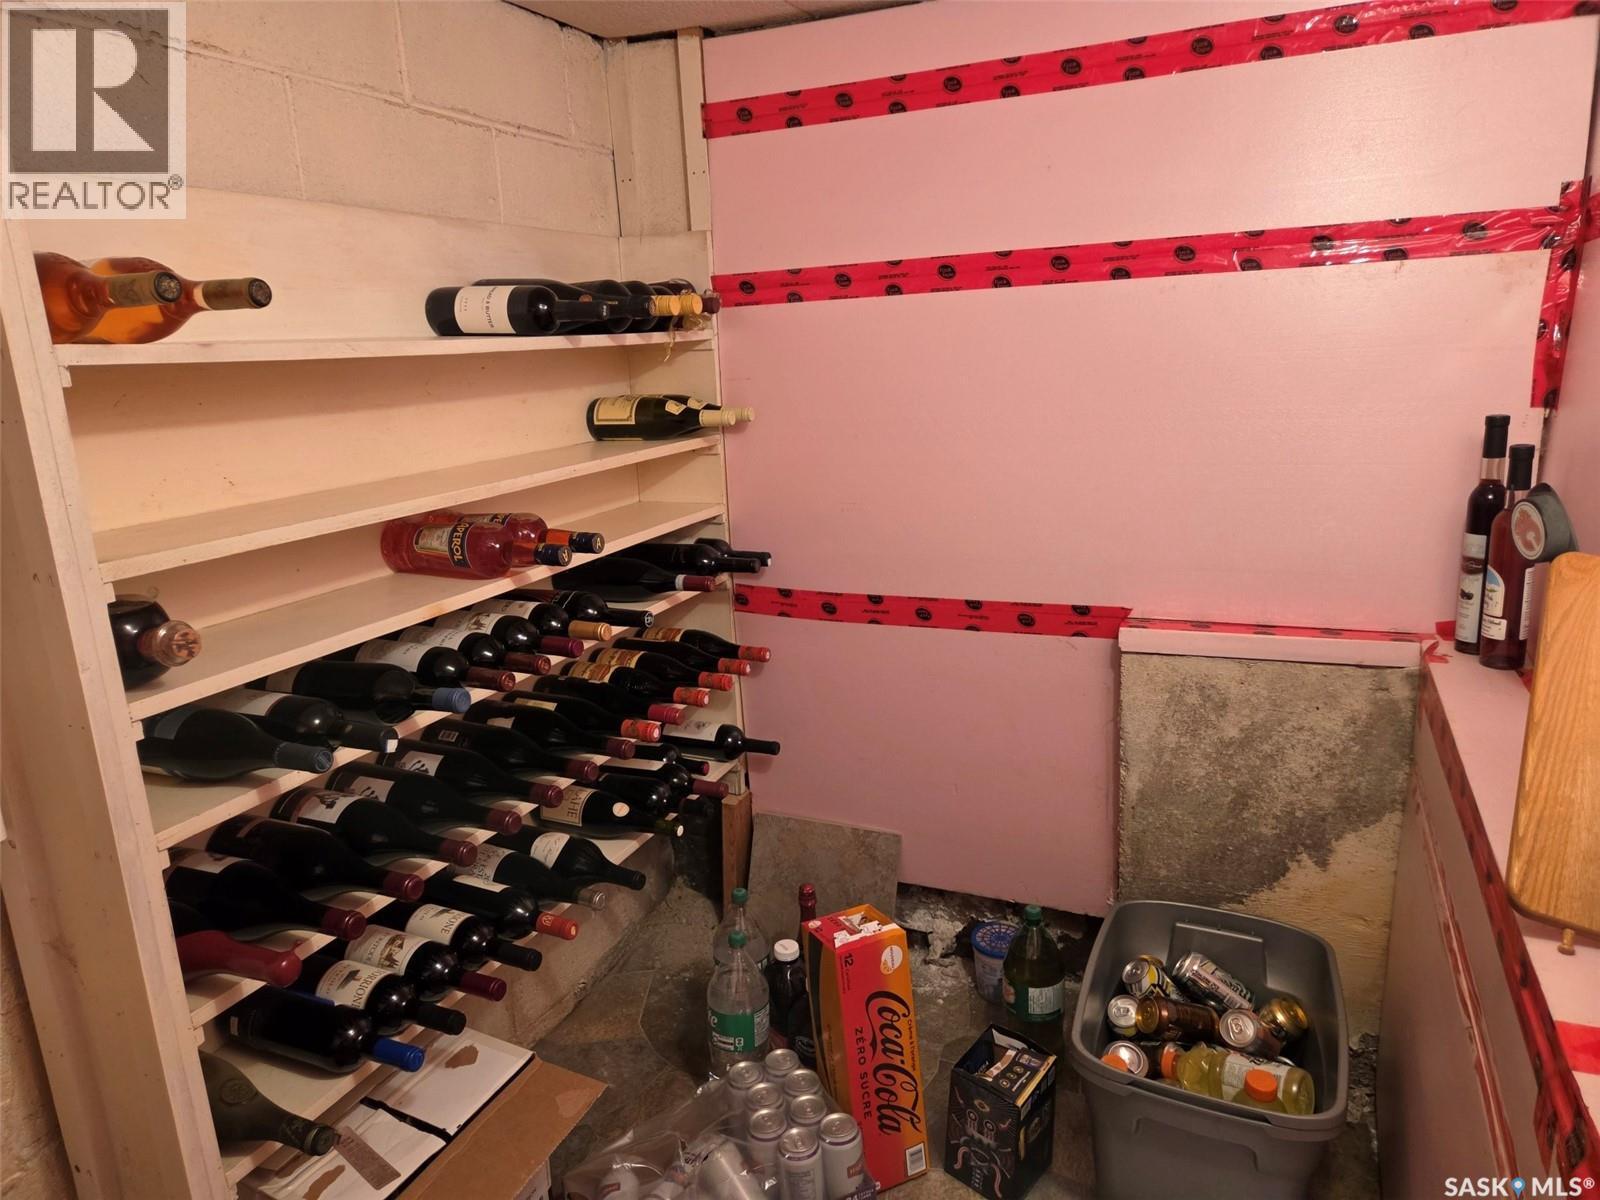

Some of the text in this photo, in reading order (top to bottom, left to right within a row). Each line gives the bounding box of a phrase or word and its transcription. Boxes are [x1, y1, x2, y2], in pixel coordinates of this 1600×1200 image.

[451, 522, 470, 561] APEROL
[844, 953, 854, 967] 12
[855, 1027, 873, 1120] ZÉRO SUCRE
